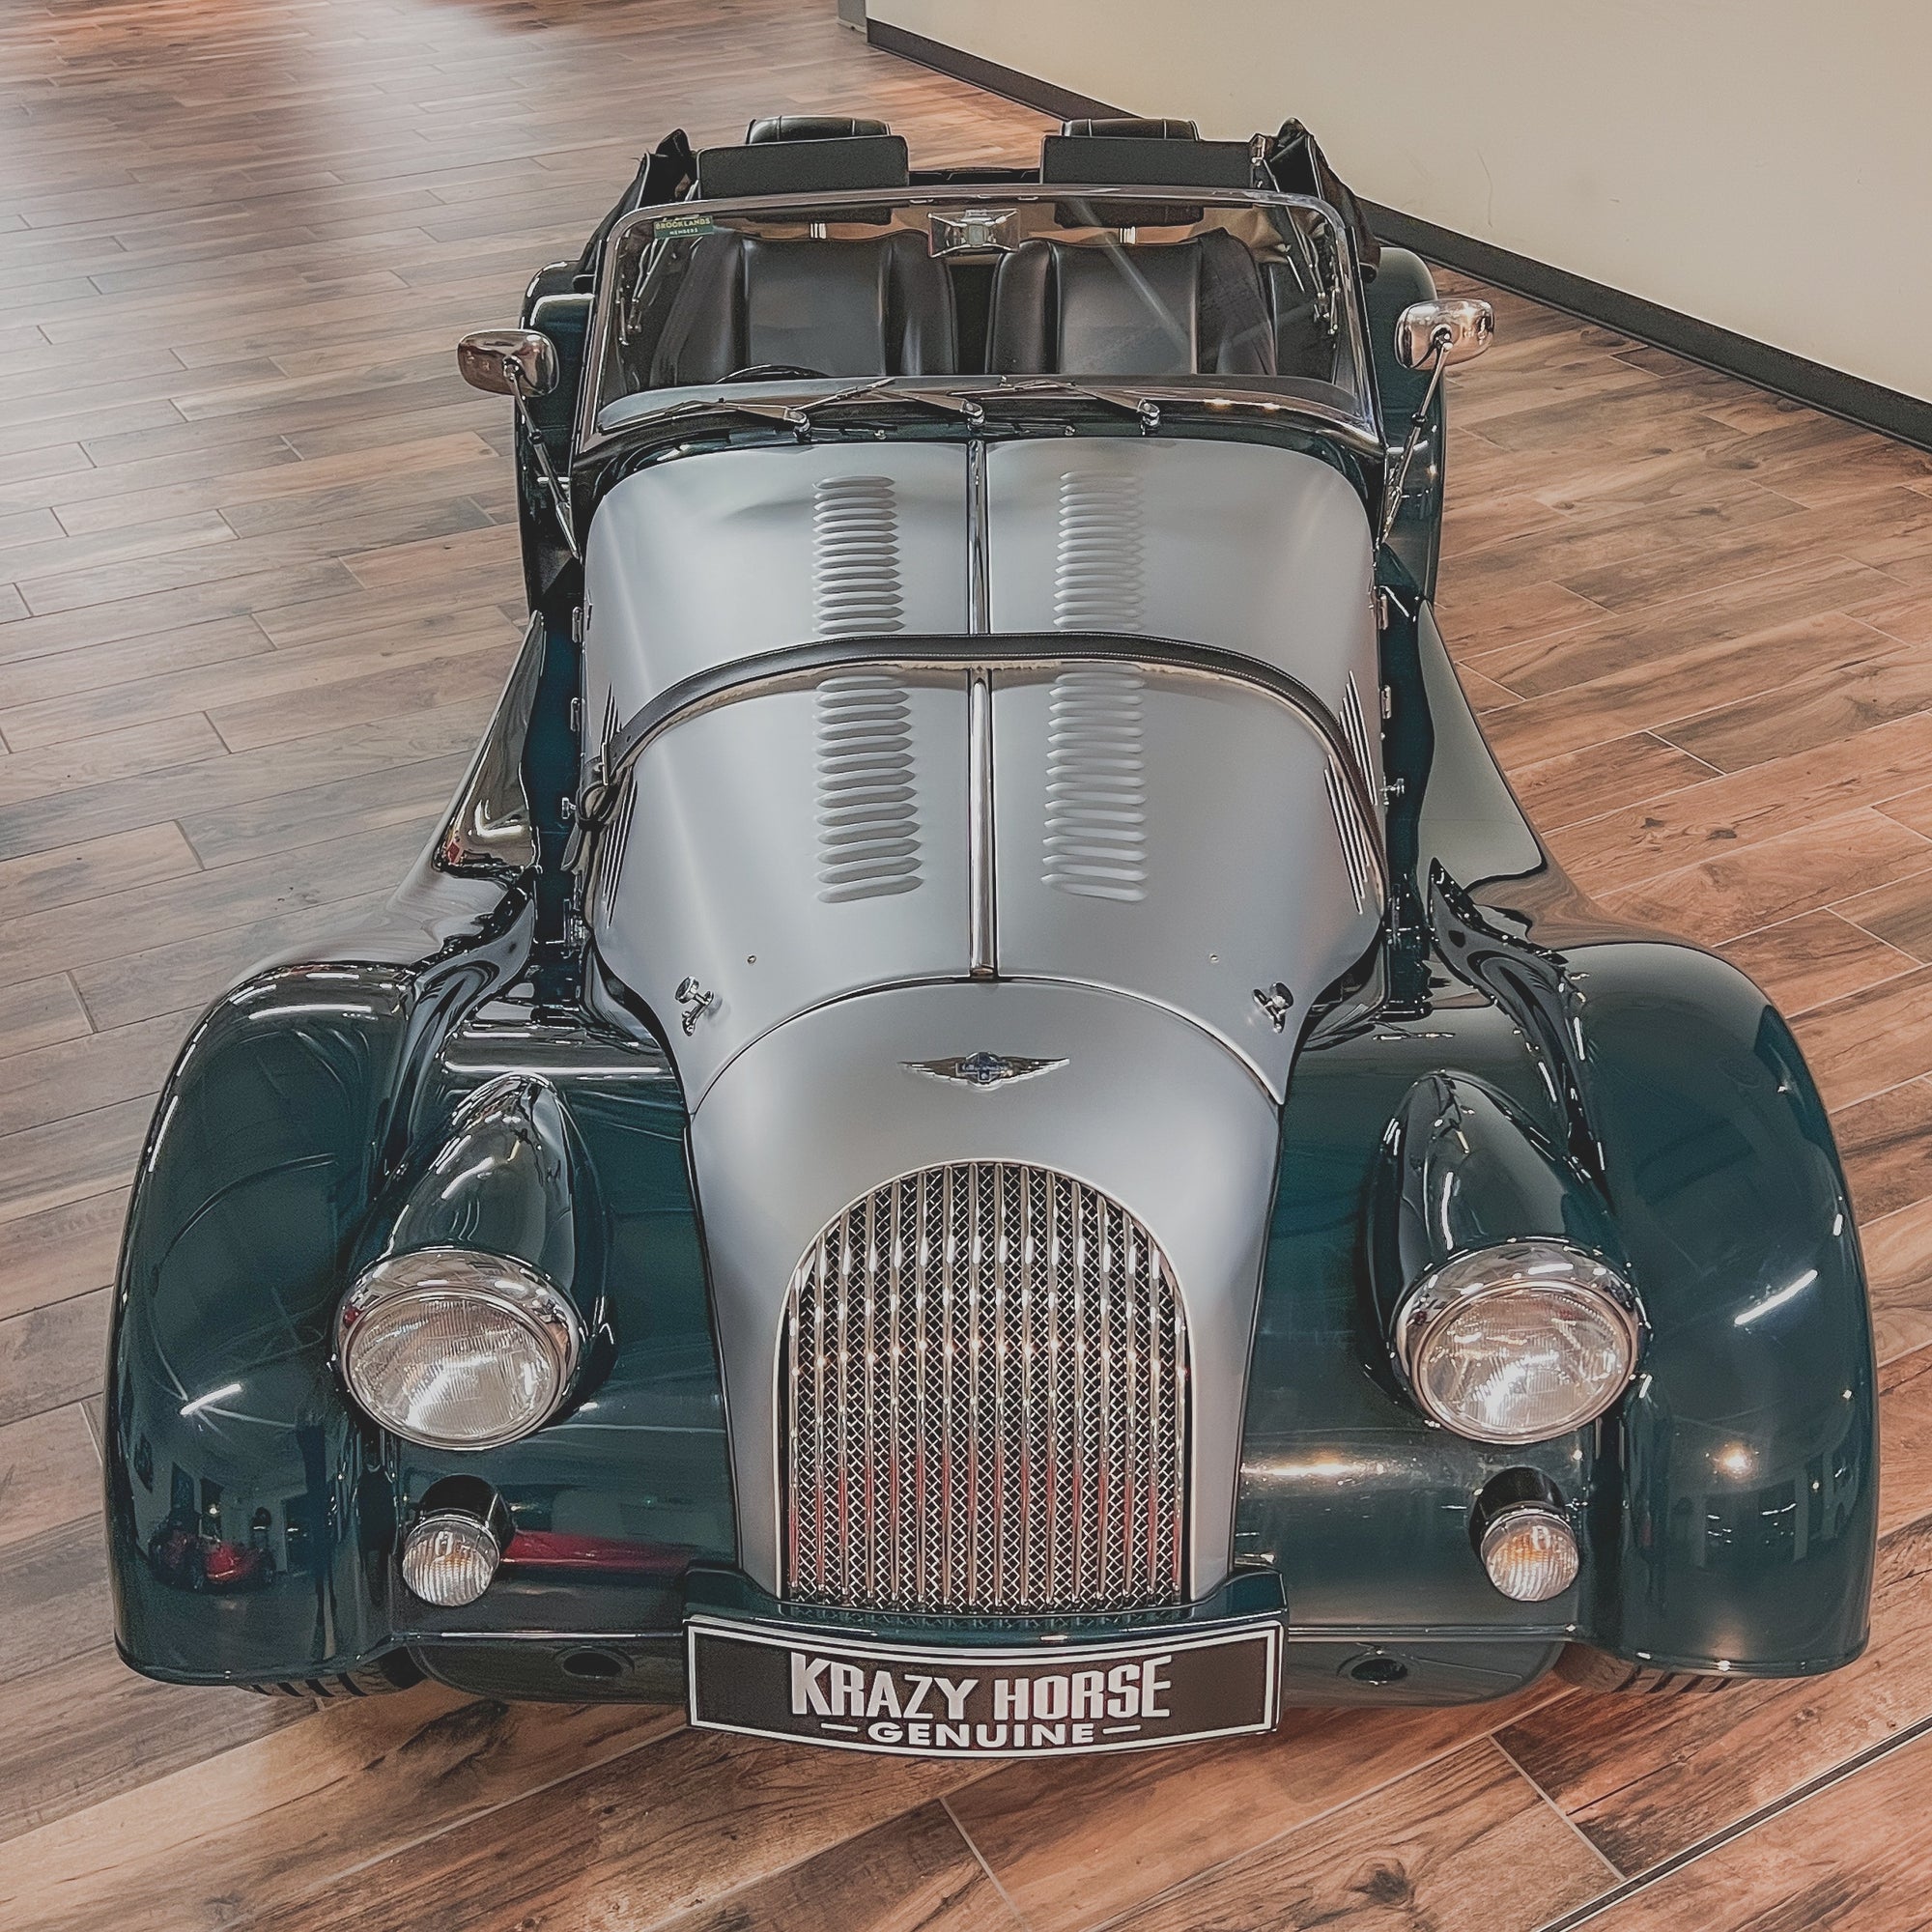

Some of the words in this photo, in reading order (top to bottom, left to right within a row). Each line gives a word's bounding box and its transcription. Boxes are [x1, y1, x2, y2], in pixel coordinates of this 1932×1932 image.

[656, 217, 711, 229] BROOKLANDS
[790, 1652, 980, 1720] KRAZY
[993, 1655, 1173, 1720] HORSE
[867, 1722, 1094, 1747] GENUINE
